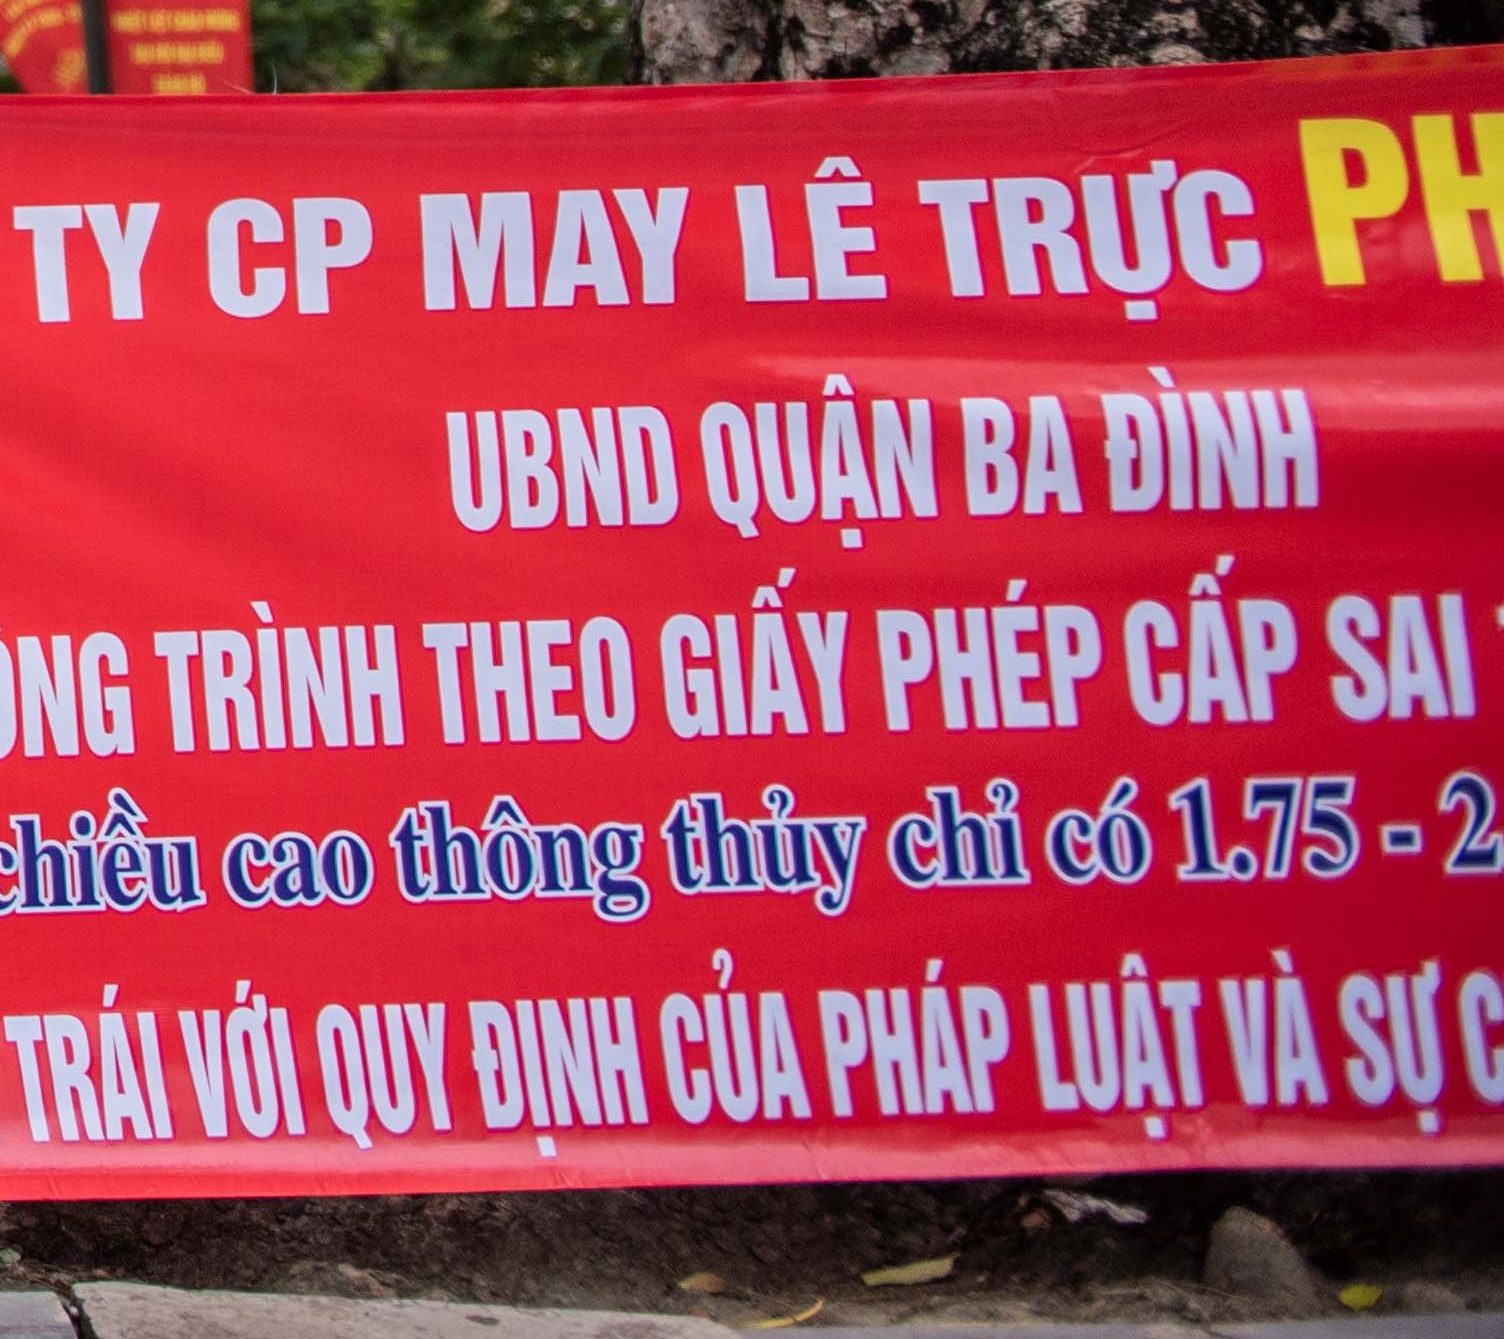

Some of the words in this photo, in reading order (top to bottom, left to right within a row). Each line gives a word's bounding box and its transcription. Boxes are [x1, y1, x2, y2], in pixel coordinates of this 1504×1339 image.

[14, 203, 160, 322] TY
[208, 198, 372, 317] CP
[420, 188, 688, 309] MAY
[735, 157, 886, 301] LÊ
[918, 161, 1260, 319] TRỰC
[447, 407, 677, 531] UBND
[701, 374, 936, 547] QUẬN
[960, 395, 1081, 514] BA
[1100, 367, 1316, 510] ĐÌNH
[154, 601, 403, 751] TRÌNH
[423, 617, 634, 743] THEO
[661, 568, 846, 737] GIẤY
[877, 580, 1099, 730] PHÉP
[1125, 556, 1294, 724] CẤP
[1328, 595, 1472, 719] SAI
[223, 830, 373, 907] cao
[389, 795, 649, 921] thông
[661, 784, 866, 915] thủy
[888, 778, 1029, 888] chỉ
[1046, 777, 1150, 883] có
[1170, 777, 1358, 879] 1.75
[3, 984, 172, 1142] TRÁI
[178, 980, 304, 1137] VỚI
[317, 1003, 450, 1149] QUY
[469, 997, 647, 1157] ĐỊNH
[661, 949, 810, 1122] CỦA
[819, 960, 1007, 1115] PHÁP
[1030, 954, 1200, 1137] LUẬT
[1221, 951, 1324, 1103] VÀ
[1341, 963, 1439, 1130] SỰ
